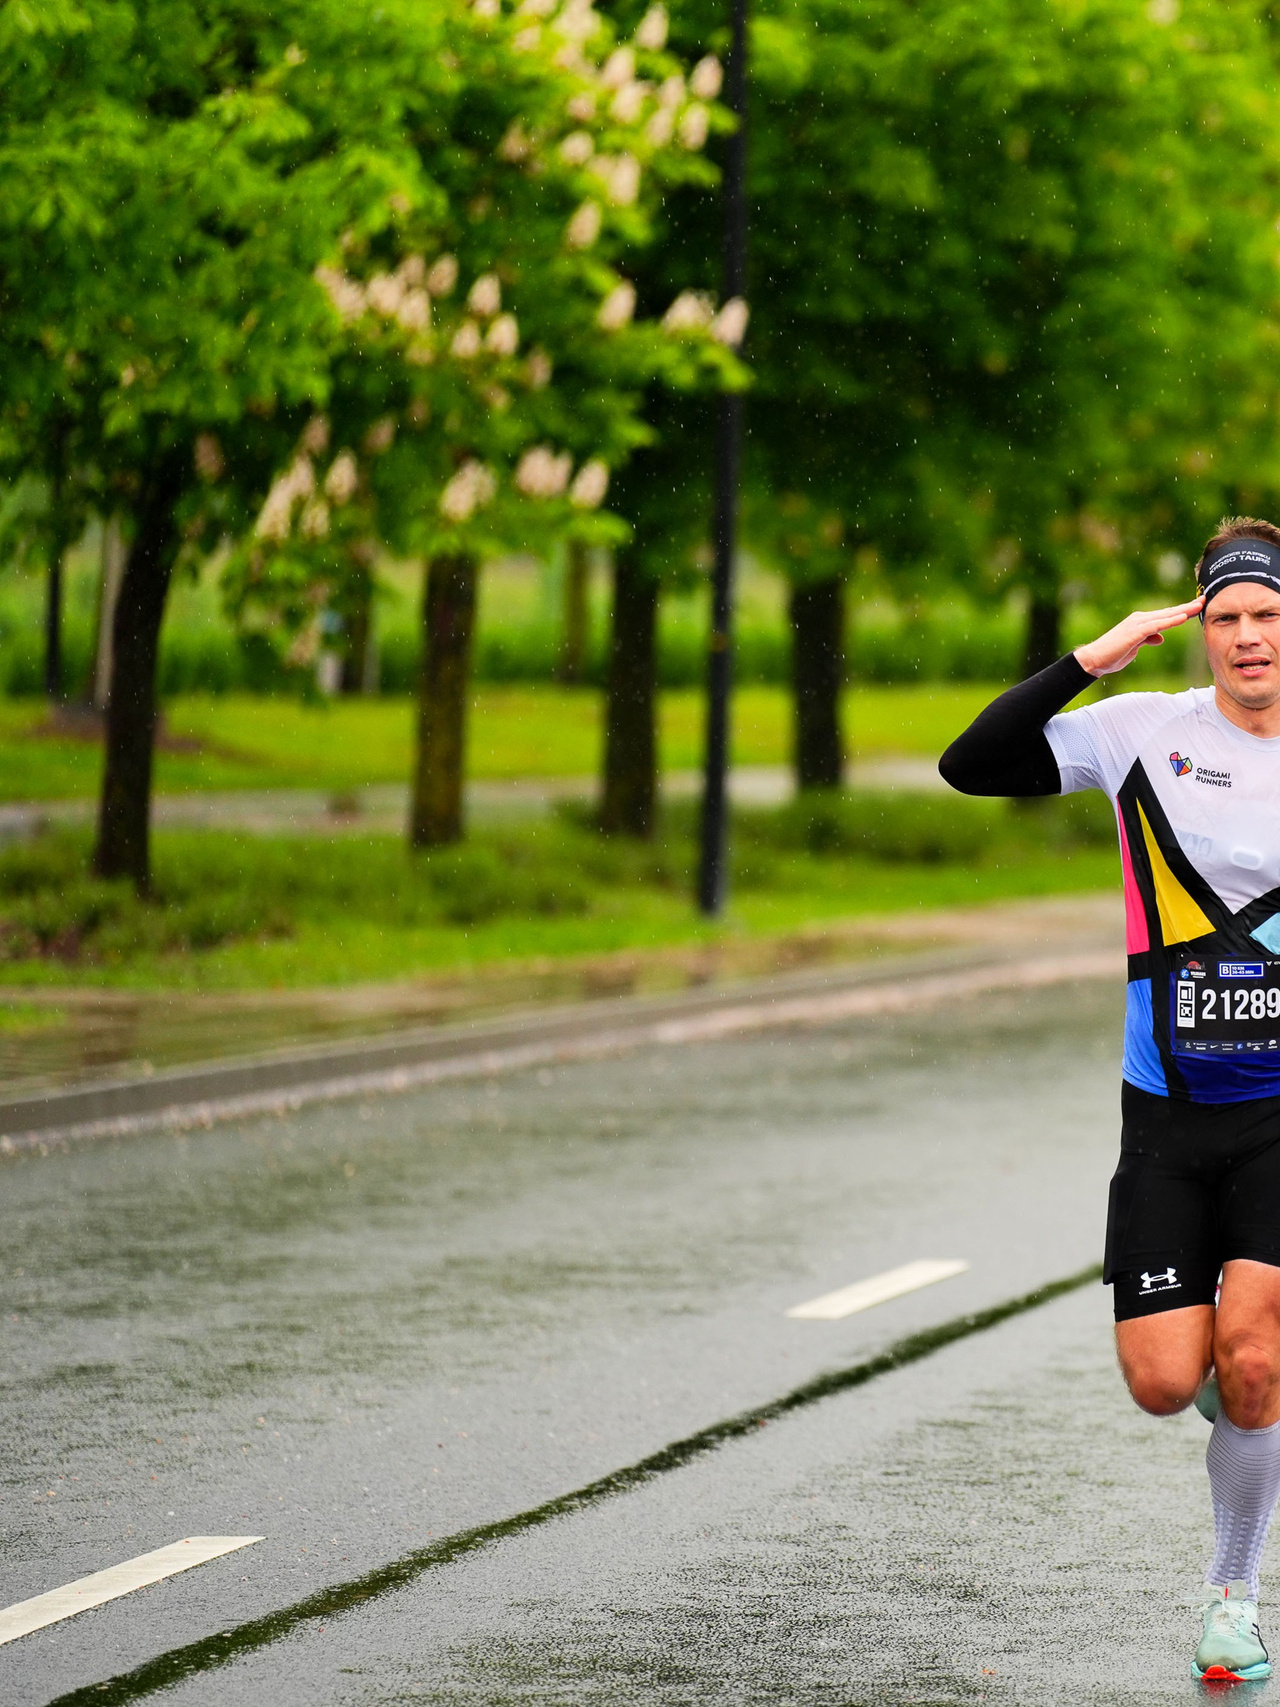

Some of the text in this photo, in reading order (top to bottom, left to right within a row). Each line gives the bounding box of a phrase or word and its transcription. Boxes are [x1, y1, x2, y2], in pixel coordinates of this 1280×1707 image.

[1196, 767, 1231, 779] ORIGAMI
[1195, 775, 1232, 788] RUNNERS
[1222, 966, 1230, 975] B
[1201, 987, 1280, 1020] 21289
